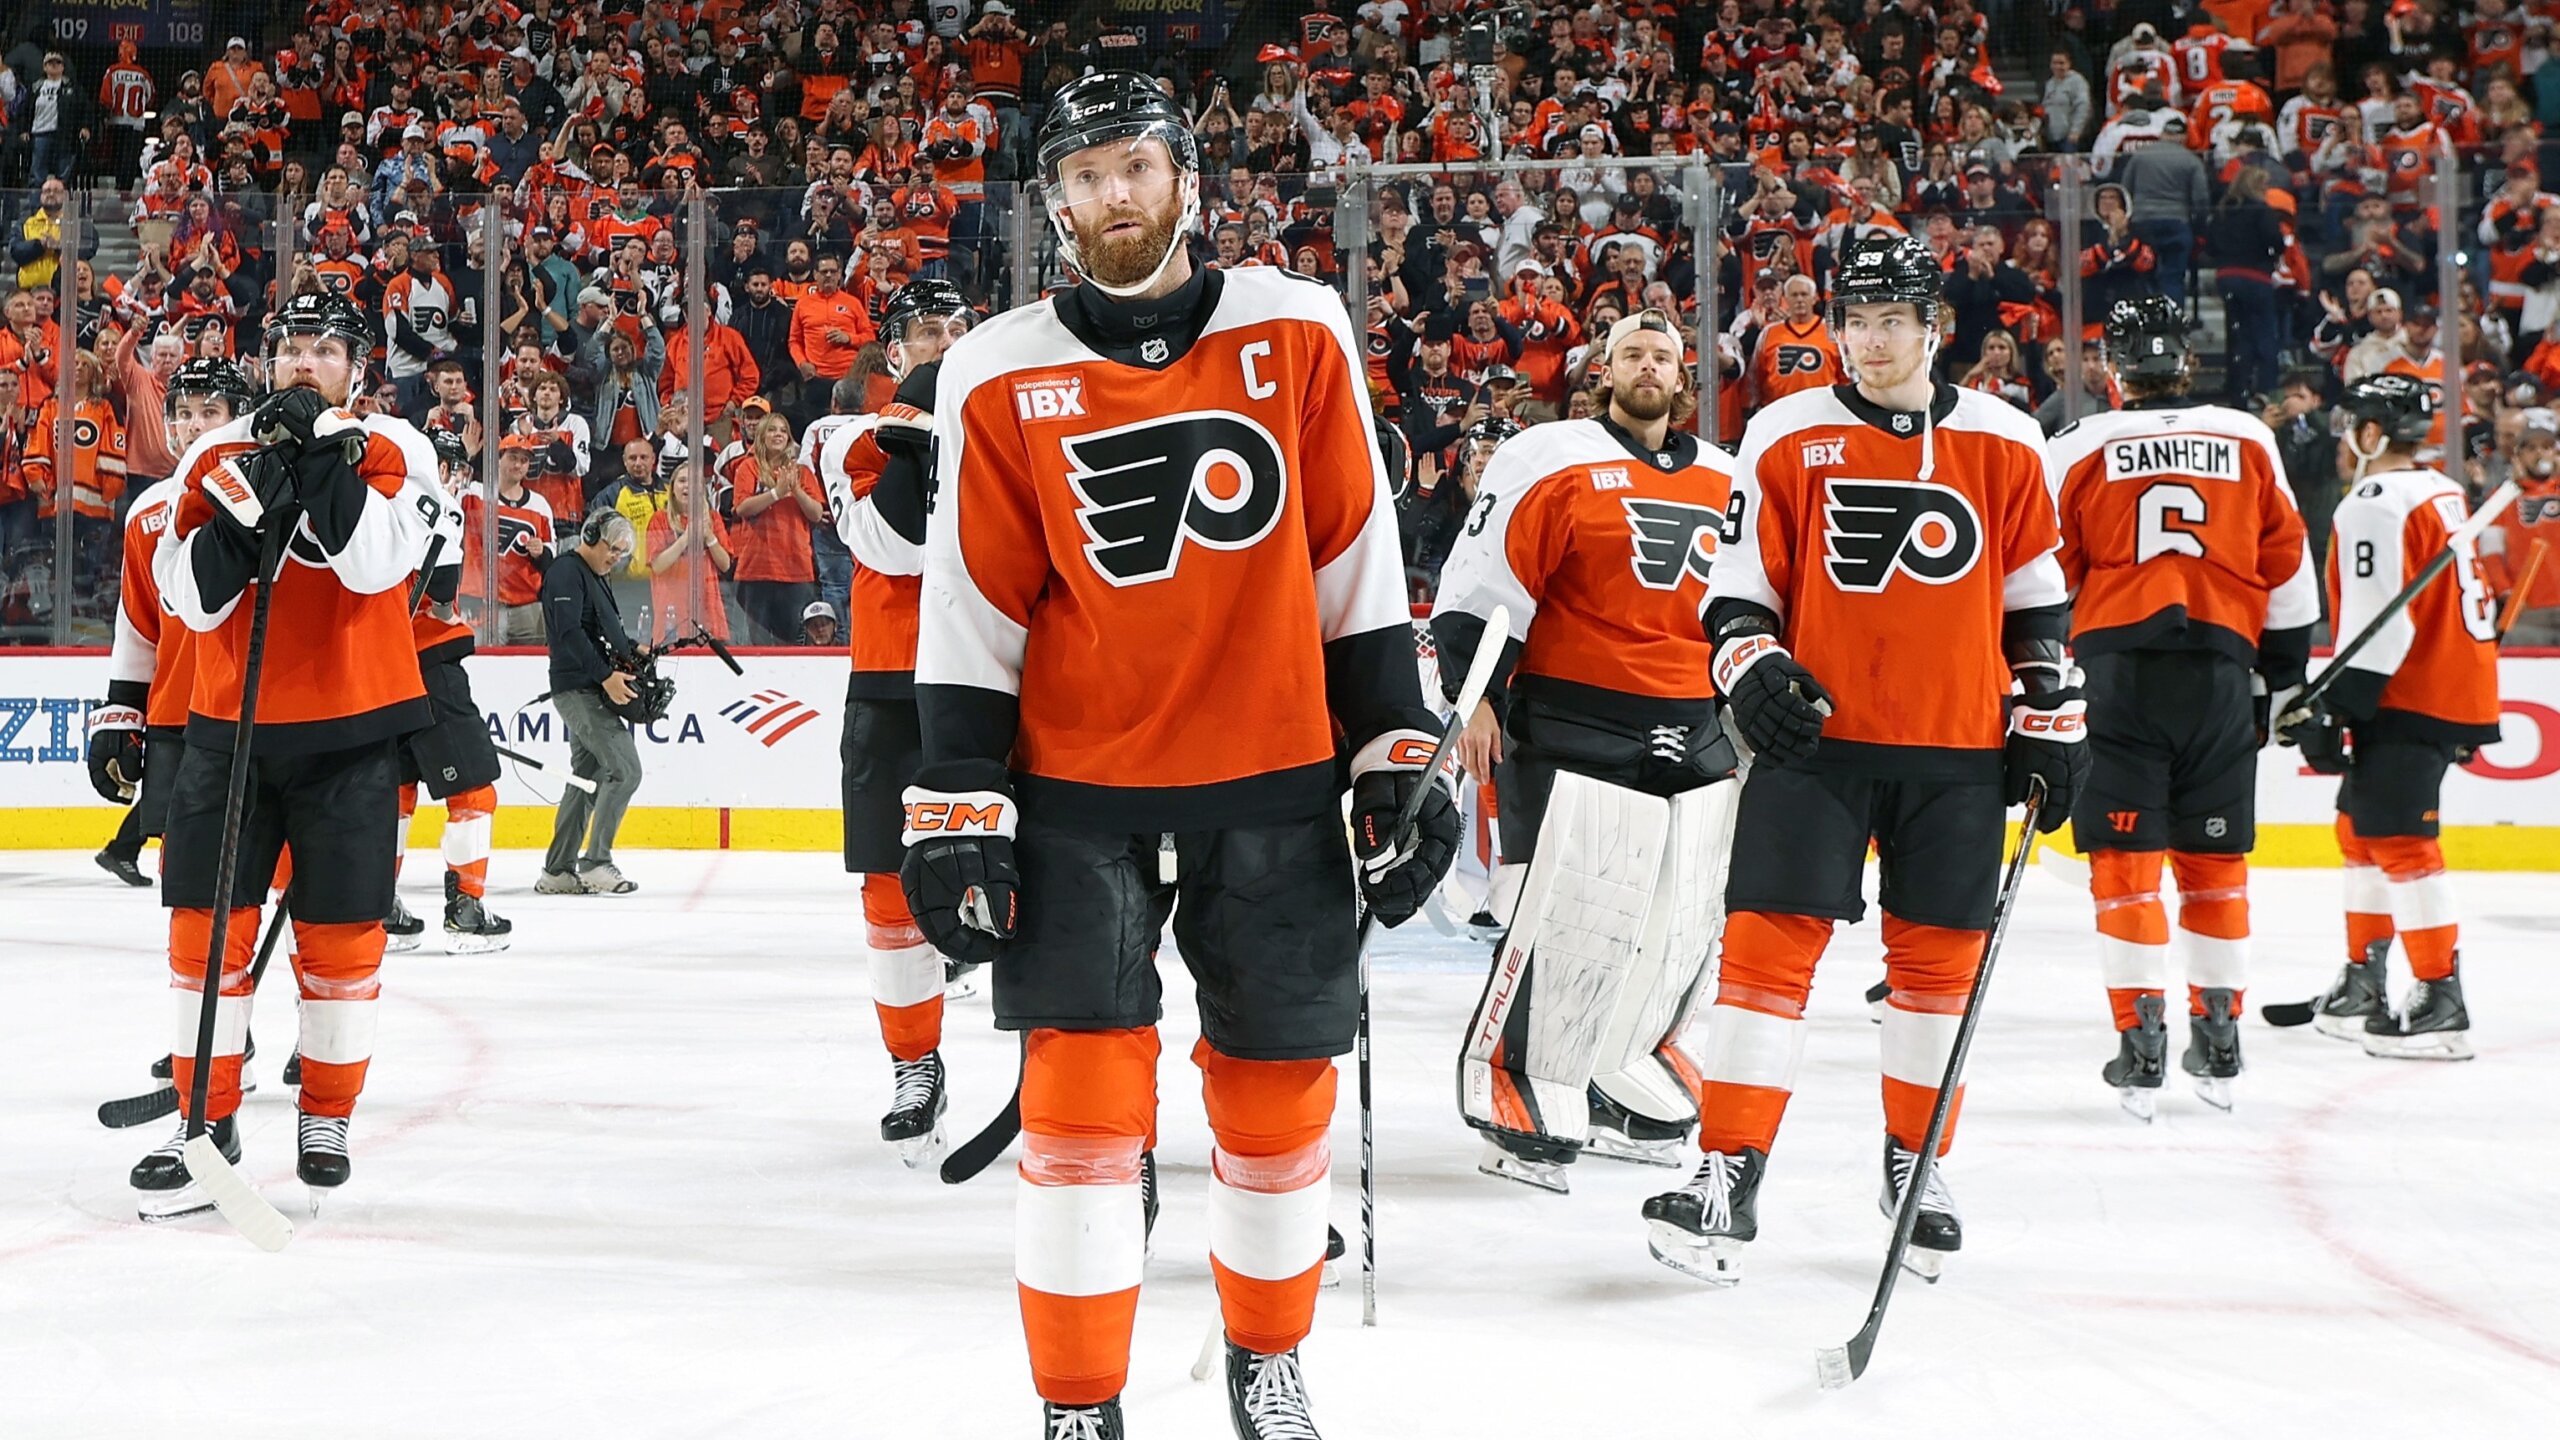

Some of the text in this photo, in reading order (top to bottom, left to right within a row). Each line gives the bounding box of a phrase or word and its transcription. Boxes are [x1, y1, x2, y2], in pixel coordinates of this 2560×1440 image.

[53, 18, 88, 40] 109
[115, 25, 139, 40] EXIT
[168, 22, 204, 43] 108
[113, 83, 145, 118] 10
[1856, 251, 1884, 268] 59
[1848, 278, 1883, 287] BAUER
[296, 295, 318, 309] 91
[387, 293, 401, 307] 12
[2152, 337, 2164, 355] 6
[1015, 378, 1070, 390] Independence
[1240, 340, 1277, 401] C
[1016, 387, 1086, 421] IBX
[1803, 442, 1846, 469] IBX
[2116, 440, 2230, 473] SANHEIM
[1591, 469, 1634, 491] IBX
[2135, 480, 2208, 565] 6
[2356, 541, 2374, 578] 8
[0, 698, 93, 763] ZI
[1364, 815, 1377, 848] CCM
[1478, 946, 1524, 1048] TRUE
[1360, 1105, 1374, 1272] PULSE
